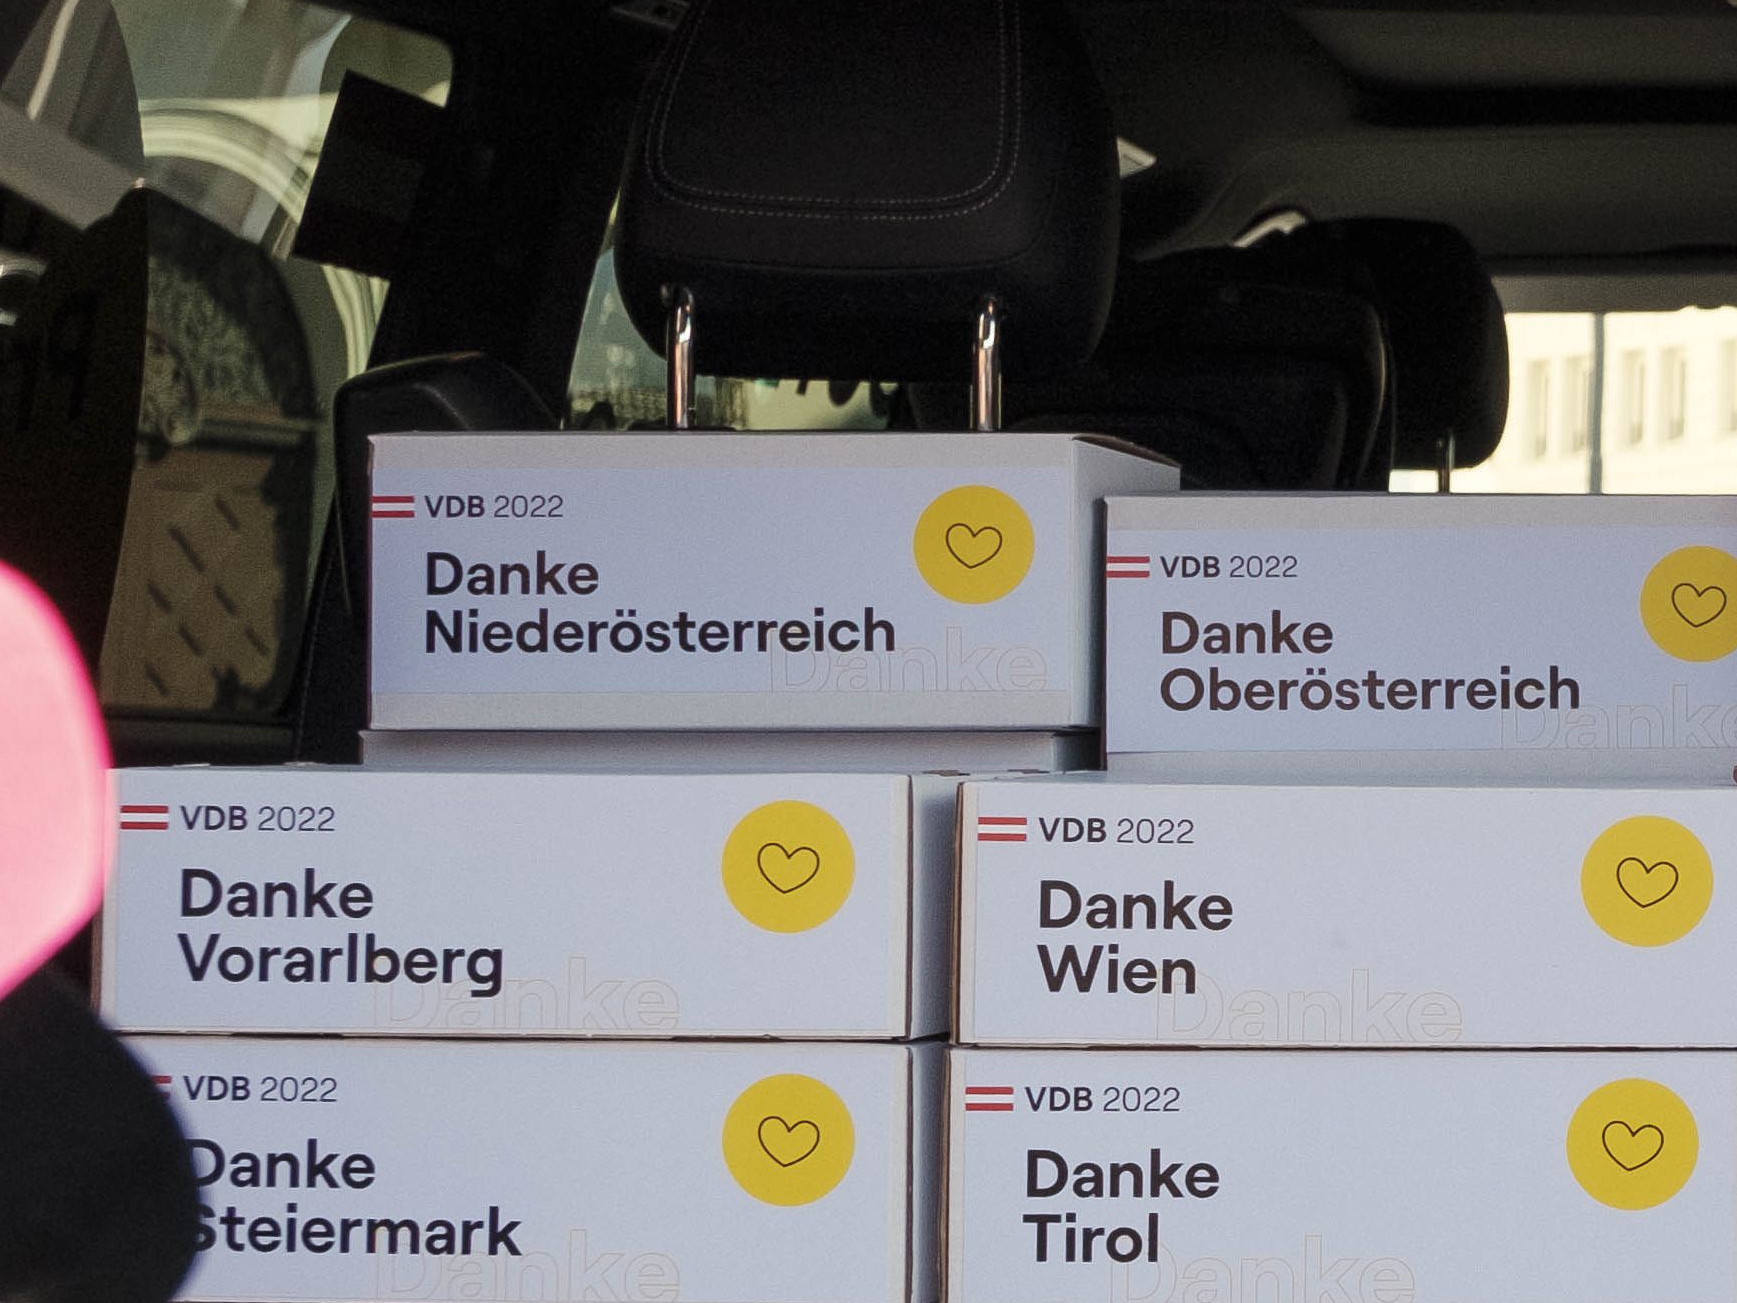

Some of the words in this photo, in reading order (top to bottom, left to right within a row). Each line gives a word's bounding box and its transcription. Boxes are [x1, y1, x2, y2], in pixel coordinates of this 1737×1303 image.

[424, 496, 484, 517] VDB
[494, 495, 563, 517] 2022
[427, 550, 598, 595] Danke
[1160, 556, 1220, 578] VDB
[1230, 556, 1297, 577] 2022
[426, 607, 894, 653] Niederösterreich
[1163, 610, 1333, 654] Danke
[1161, 665, 1579, 711] Oberösterreich
[181, 806, 247, 830] VDB
[258, 806, 334, 831] 2022
[1039, 818, 1106, 842] VDB
[1117, 818, 1194, 843] 2022
[181, 868, 373, 918] Danke
[1040, 880, 1232, 930] Danke
[178, 933, 502, 997] Vorarlberg
[1037, 944, 1195, 994] Wien
[183, 1076, 250, 1100] VDB
[261, 1077, 337, 1102] 2022
[1025, 1087, 1093, 1111] VDB
[1104, 1087, 1180, 1111] 2022
[1027, 1149, 1219, 1198] Danke
[1023, 1213, 1158, 1262] Tirol
